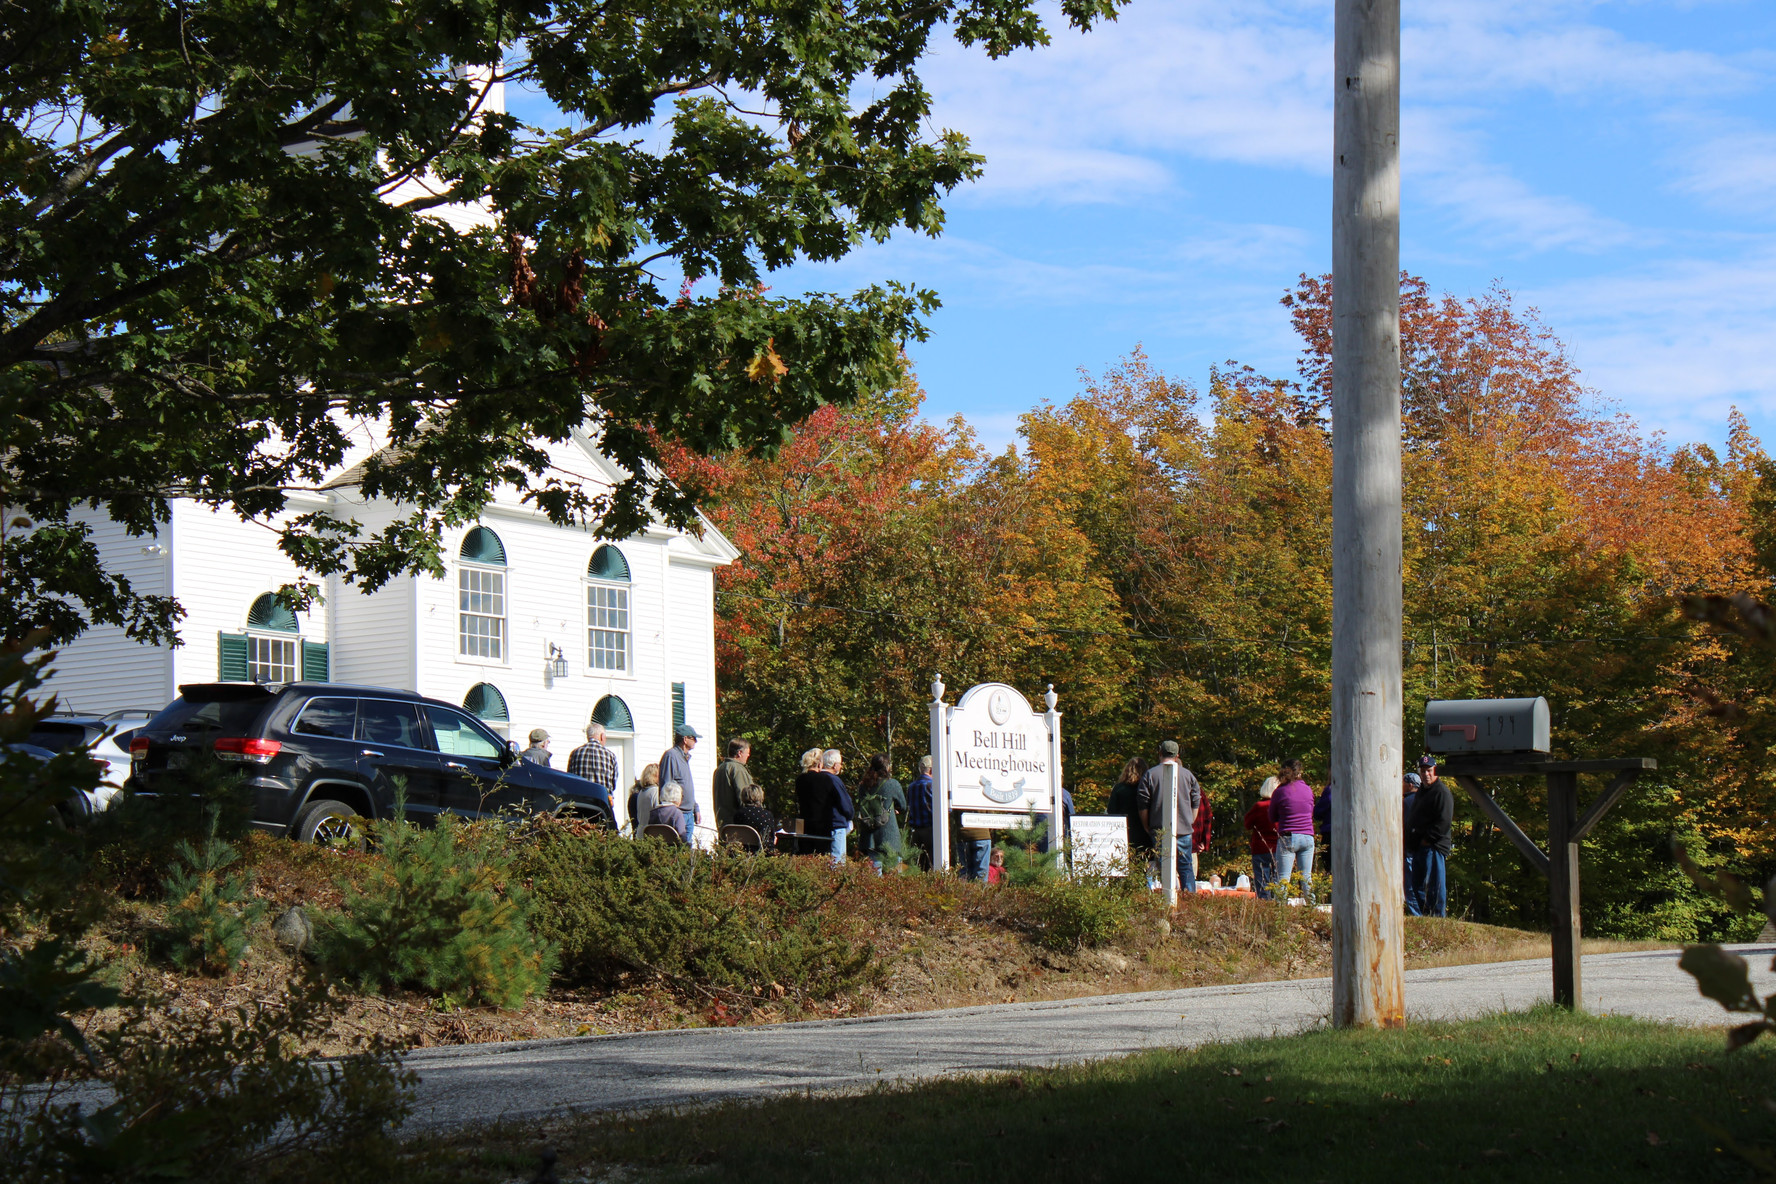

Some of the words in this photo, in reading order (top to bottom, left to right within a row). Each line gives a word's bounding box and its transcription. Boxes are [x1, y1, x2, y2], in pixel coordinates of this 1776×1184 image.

[1486, 715, 1515, 736] 194
[170, 734, 187, 743] Jeep
[973, 730, 998, 748] Bell
[1002, 732, 1026, 750] Hill
[955, 750, 1046, 777] Meetinghouse
